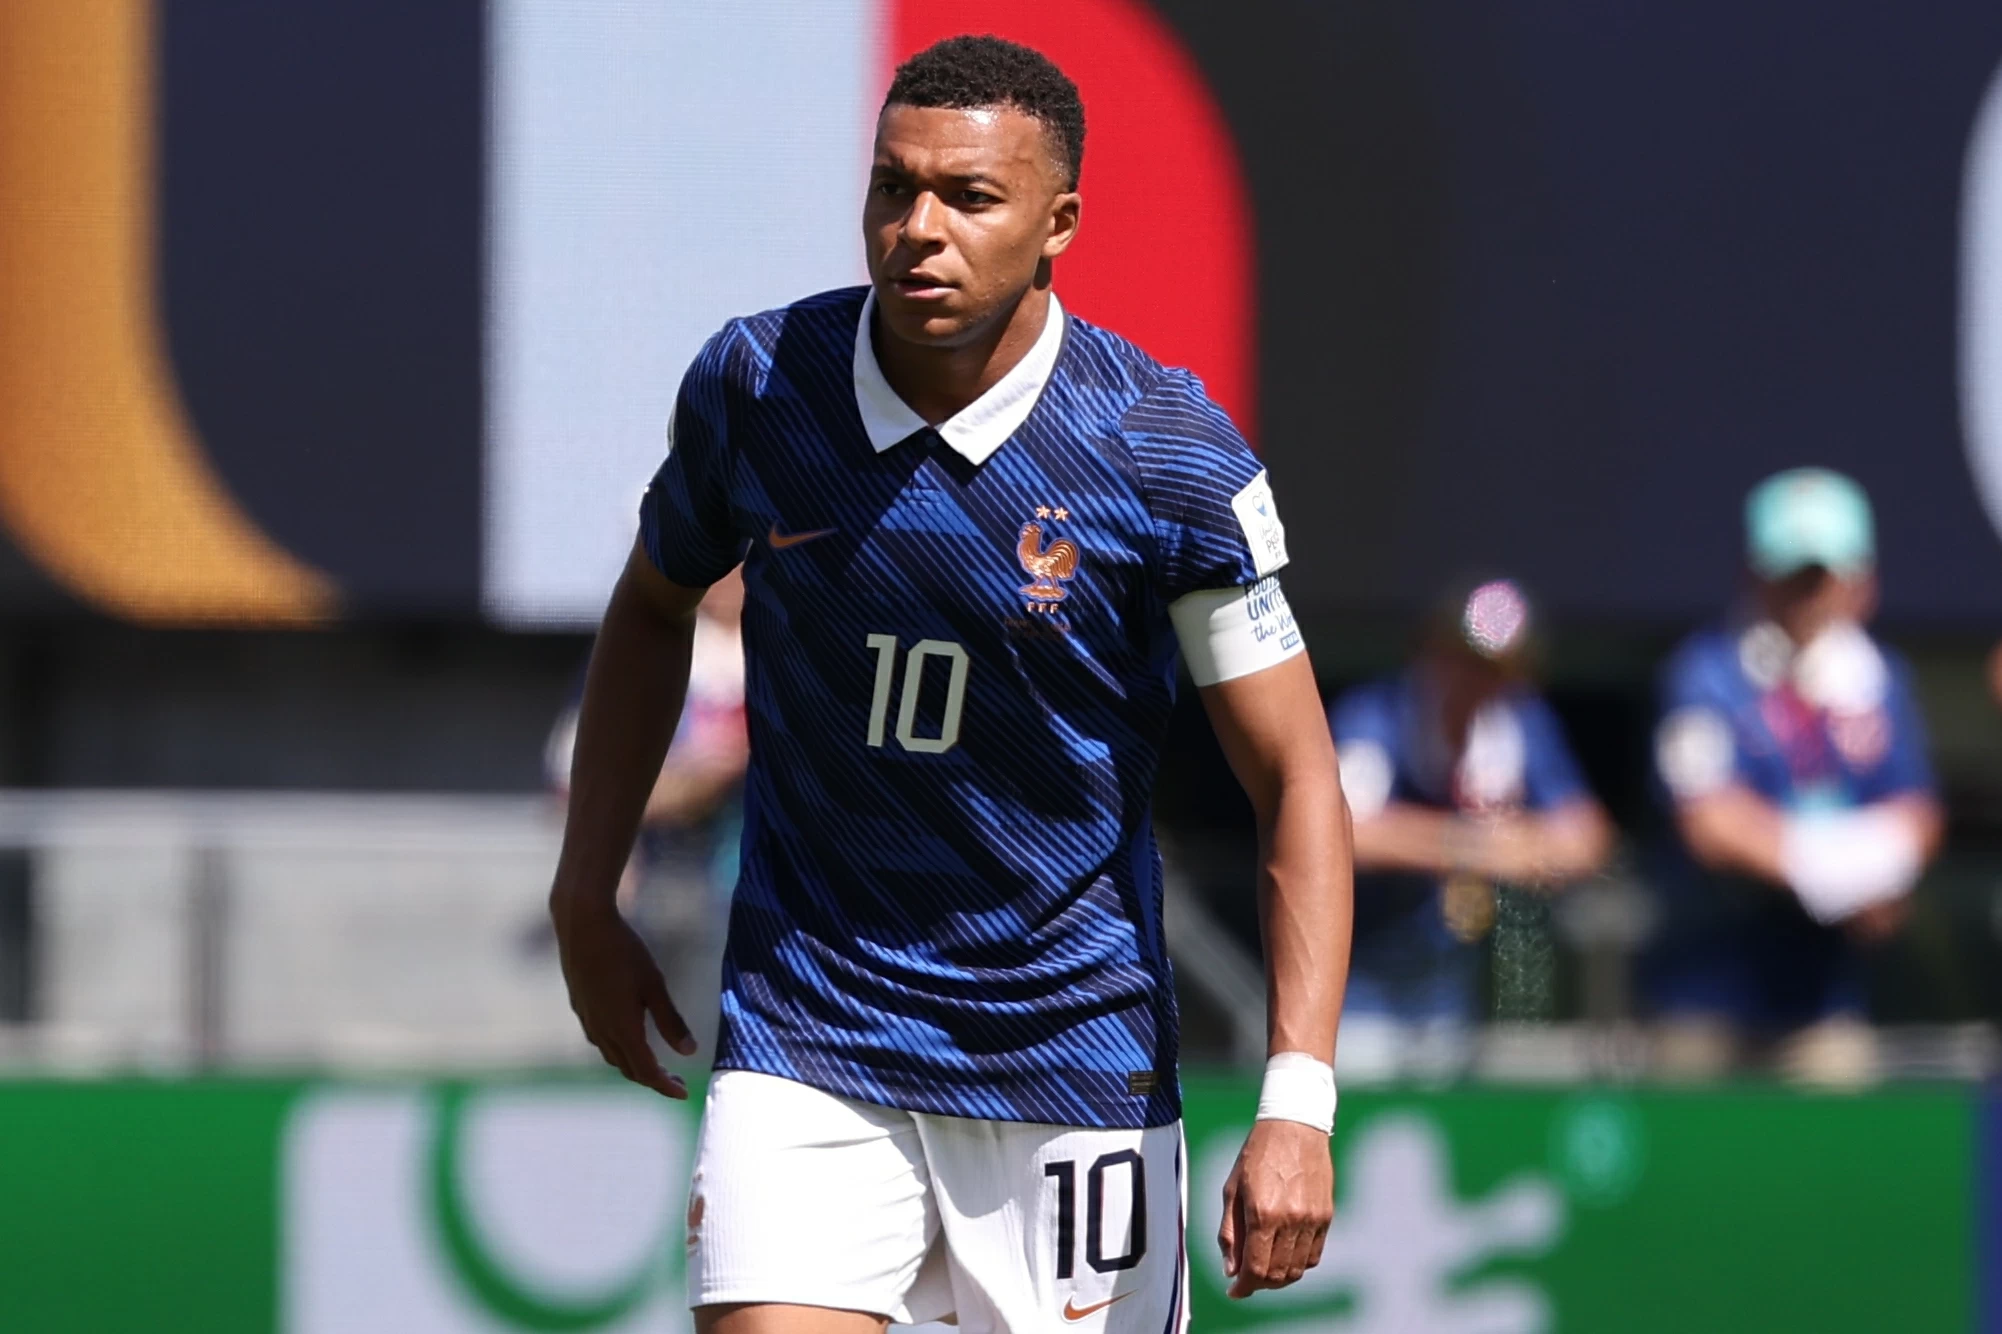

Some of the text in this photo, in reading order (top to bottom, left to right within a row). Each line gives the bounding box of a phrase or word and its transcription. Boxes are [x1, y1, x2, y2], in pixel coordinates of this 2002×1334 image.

[1250, 621, 1277, 643] the
[866, 633, 969, 754] 10
[1044, 1148, 1147, 1279] 10
